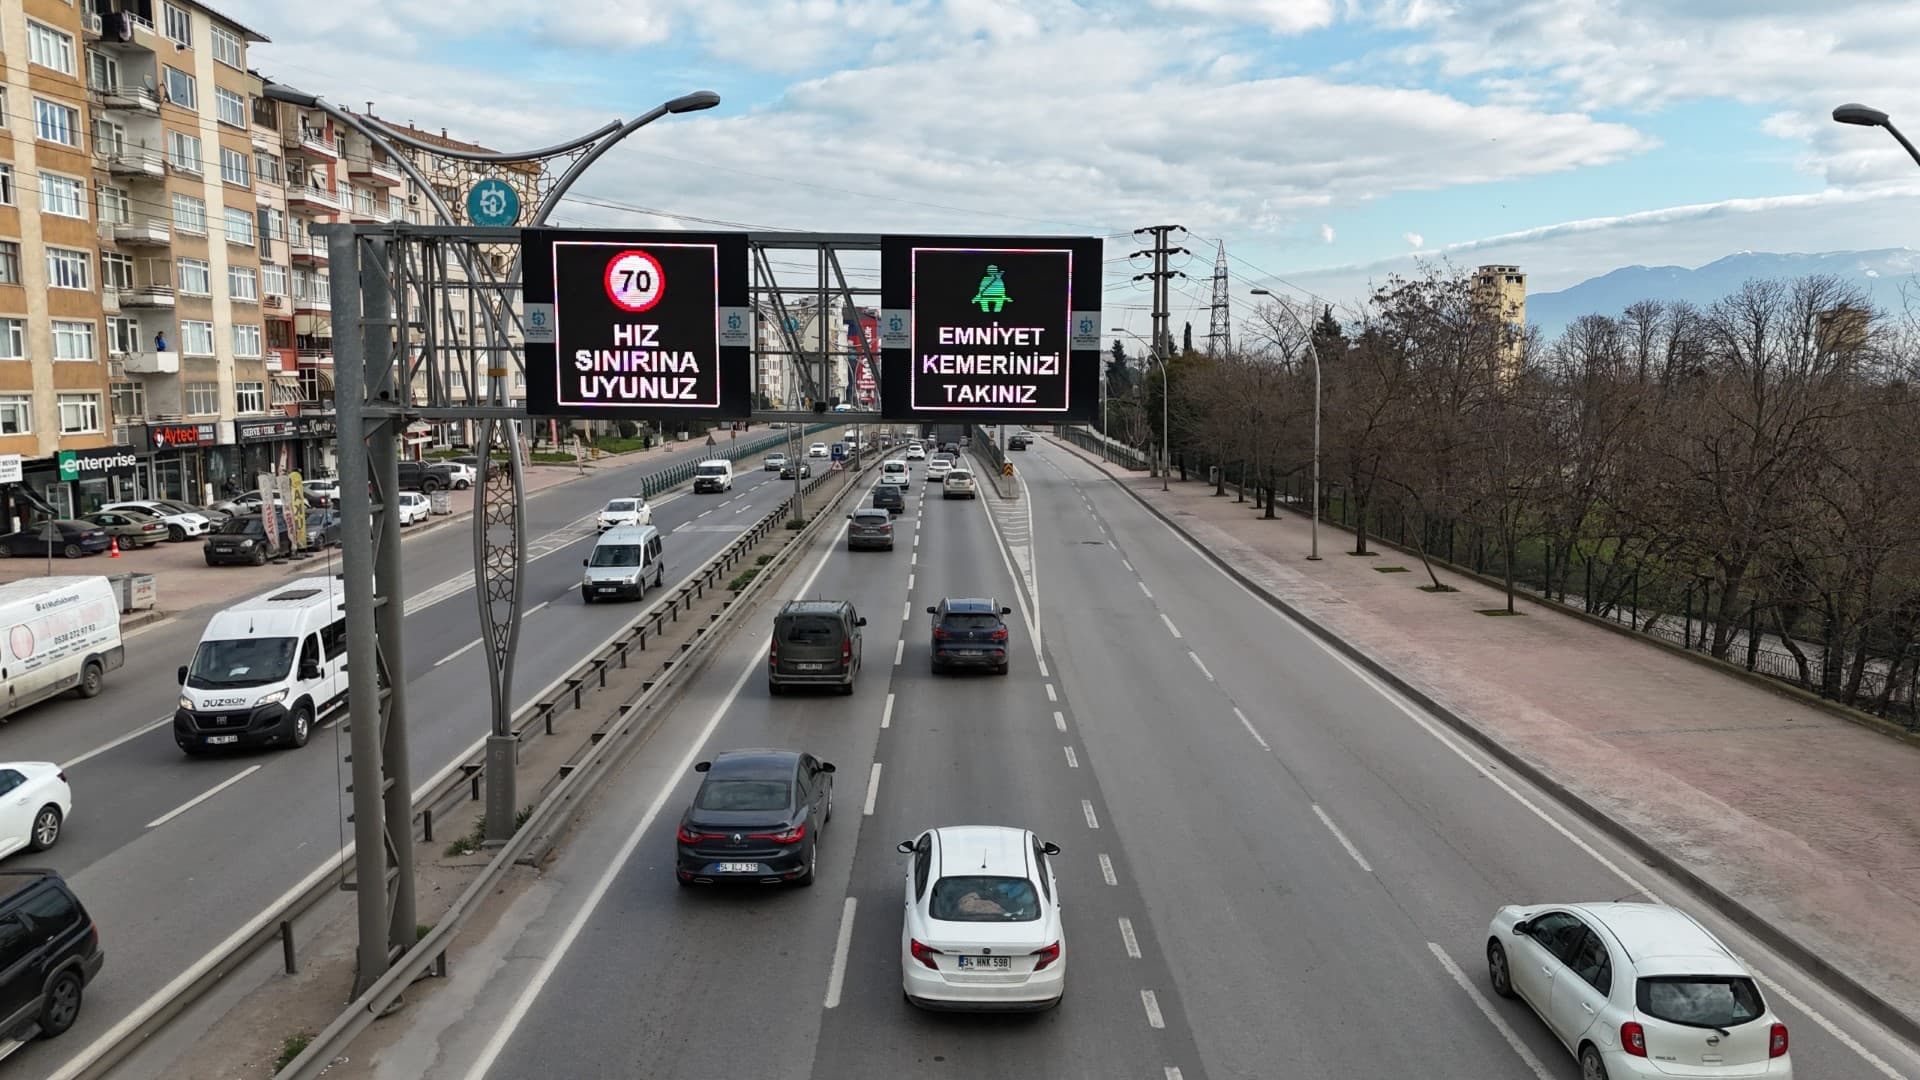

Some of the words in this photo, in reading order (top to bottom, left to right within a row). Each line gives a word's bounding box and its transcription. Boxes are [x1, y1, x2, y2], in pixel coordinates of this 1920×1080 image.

[619, 270, 651, 292] 70
[613, 324, 660, 347] HIZ
[939, 321, 1045, 346] EMNİYET
[575, 350, 699, 373] SINIRINA
[922, 352, 1060, 375] KEMERİNİZİ
[580, 375, 698, 400] UYUNUZ
[942, 384, 1037, 404] TAKINIZ
[164, 425, 199, 447] Aytech
[60, 452, 136, 473] enterprise
[964, 957, 974, 967] 34
[976, 957, 991, 967] HNK
[993, 958, 1008, 968] 598
